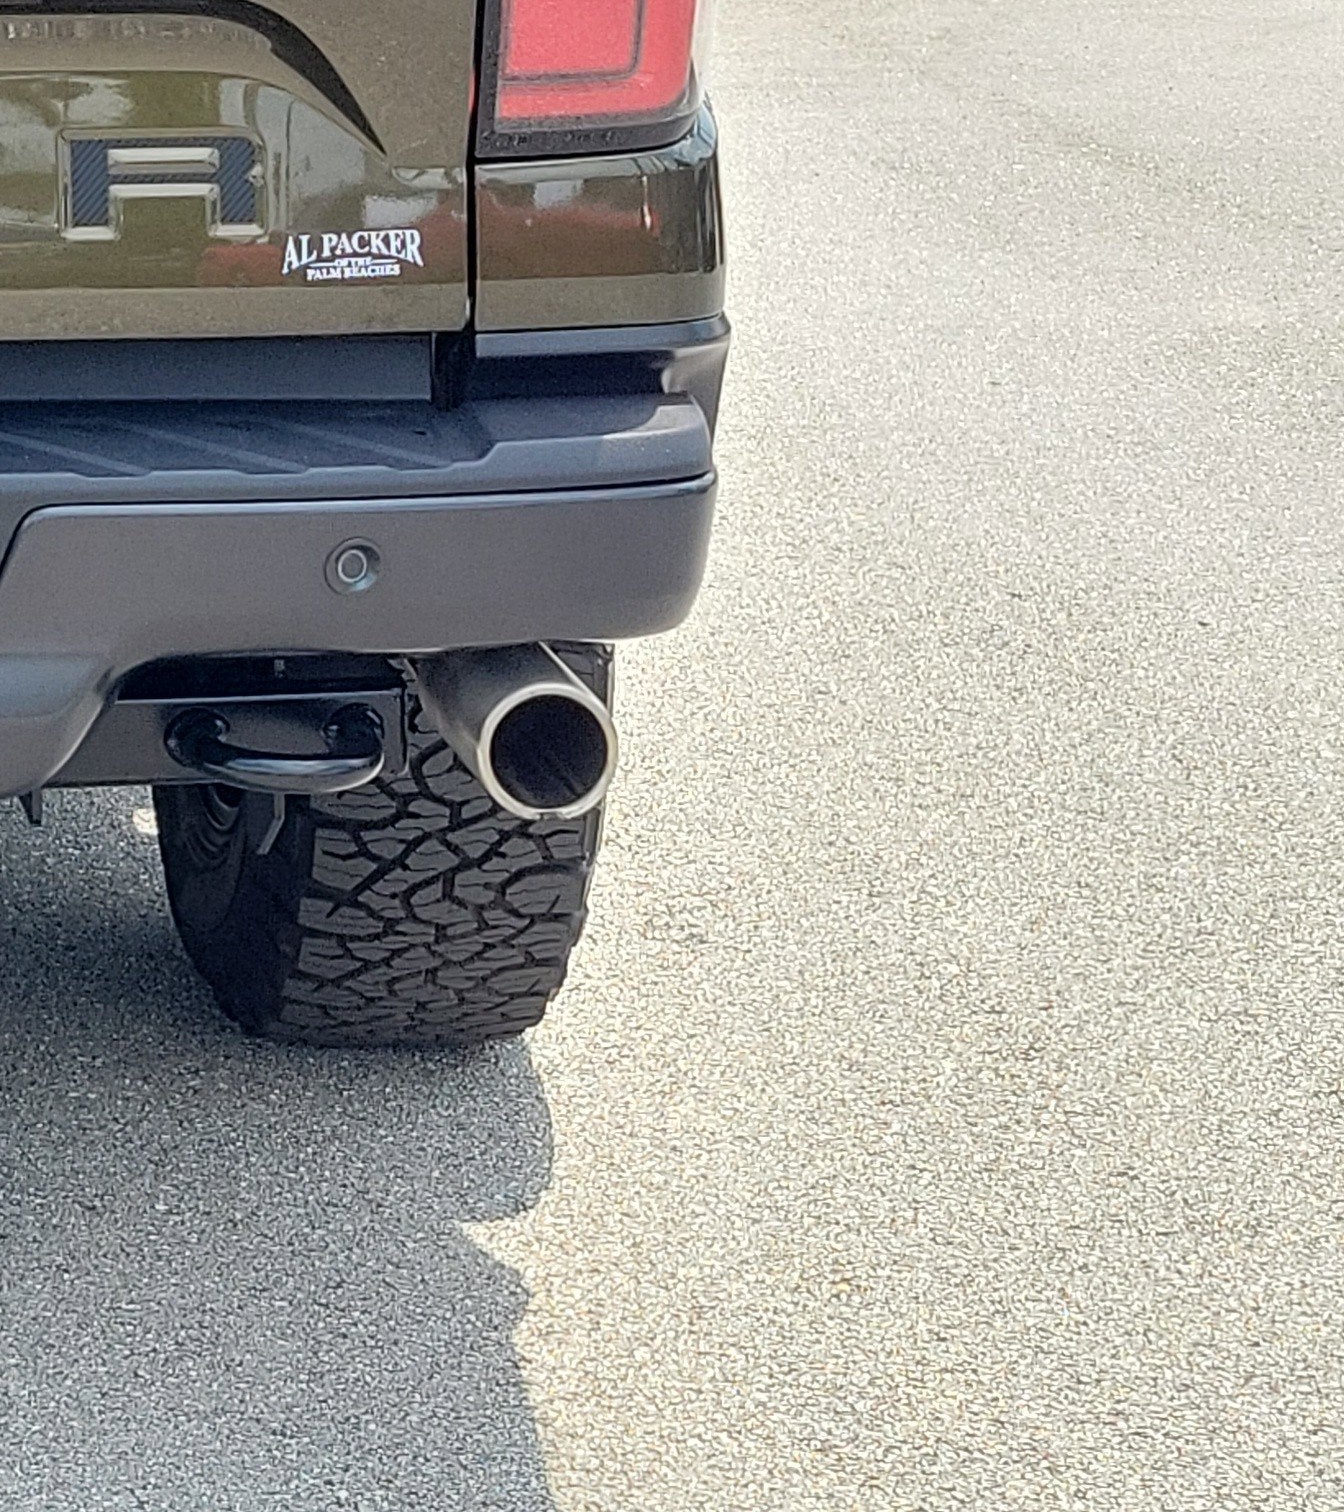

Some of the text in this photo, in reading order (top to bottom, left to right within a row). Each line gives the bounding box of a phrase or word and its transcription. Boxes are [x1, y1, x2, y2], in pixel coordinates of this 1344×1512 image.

[281, 228, 424, 275] AL PACKER
[306, 264, 401, 281] PALM BEACHES
